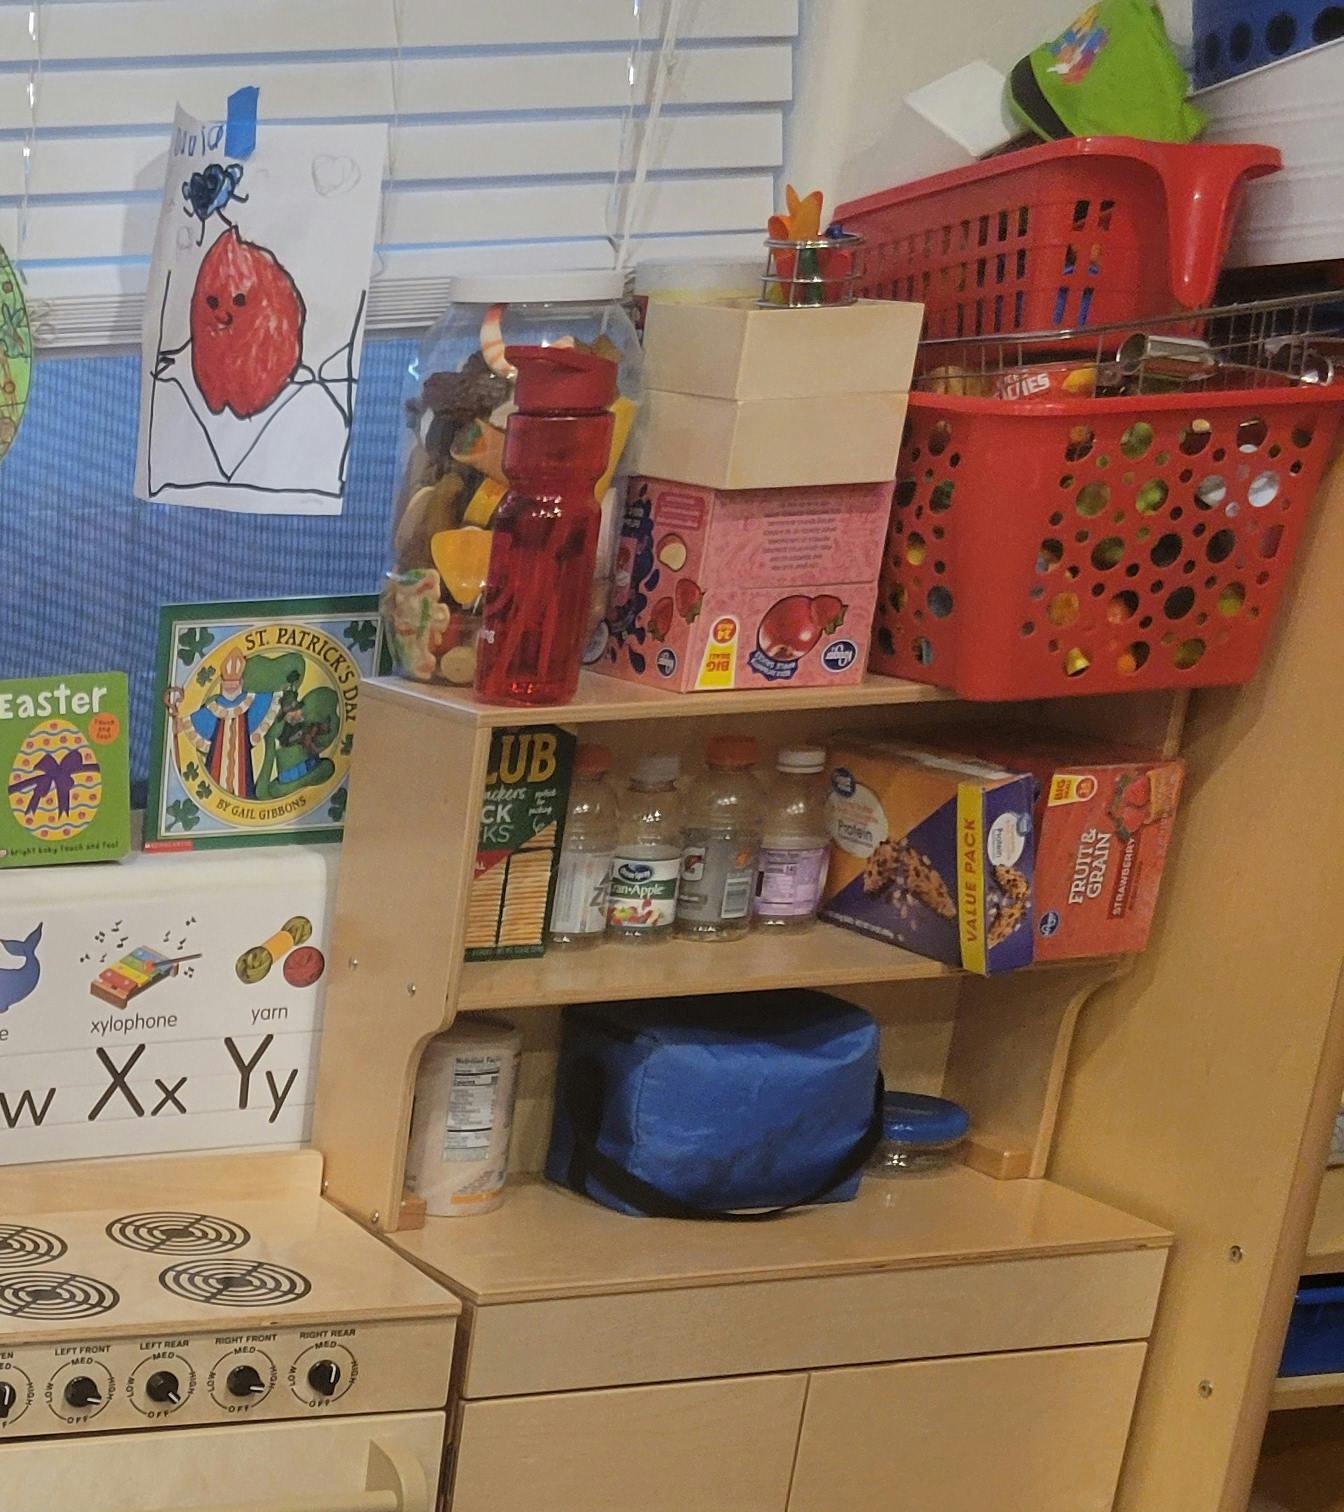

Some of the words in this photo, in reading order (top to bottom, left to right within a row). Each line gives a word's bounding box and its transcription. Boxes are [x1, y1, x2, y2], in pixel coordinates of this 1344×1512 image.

[244, 630, 270, 651] ST.
[276, 627, 356, 685] PATRICK'S
[706, 660, 730, 672] BIG
[216, 797, 230, 811] BY
[231, 805, 257, 820] GAIL
[259, 795, 307, 820] GIBBONS
[964, 817, 977, 876] PACK
[1068, 847, 1094, 904] FRUIT
[1081, 828, 1097, 843] &
[1087, 832, 1111, 898] GRAIN
[1112, 837, 1136, 916] STRAWBERRY
[965, 882, 977, 943] VALUE
[90, 1013, 178, 1036] xylophone
[251, 1005, 288, 1025] yarn
[88, 1043, 187, 1121] Xx
[223, 1034, 299, 1123] Yy
[139, 1341, 162, 1351] LEFT
[164, 1339, 189, 1349] REAR
[215, 1335, 244, 1345] RIGHT
[246, 1333, 277, 1343] FRONT
[299, 1330, 328, 1340] RIGHT
[330, 1328, 356, 1338] REAR
[314, 1340, 337, 1349] MED
[54, 1346, 78, 1356] LEFT
[79, 1344, 111, 1355] FRONT
[152, 1351, 174, 1360] MED
[233, 1345, 256, 1355] MED
[71, 1357, 93, 1366] MED
[350, 1360, 359, 1385] HIGH
[125, 1376, 135, 1397] LOW
[188, 1371, 197, 1395] HIGH
[206, 1371, 216, 1393] LOW
[269, 1365, 278, 1389] HIGH
[287, 1365, 297, 1387] LOW
[26, 1381, 35, 1406] HIGH
[44, 1382, 54, 1403] LOW
[107, 1376, 116, 1400] HIGH
[147, 1409, 170, 1418] OFF
[228, 1404, 250, 1413] OFF
[309, 1398, 331, 1408] OFF
[67, 1415, 89, 1424] OFF
